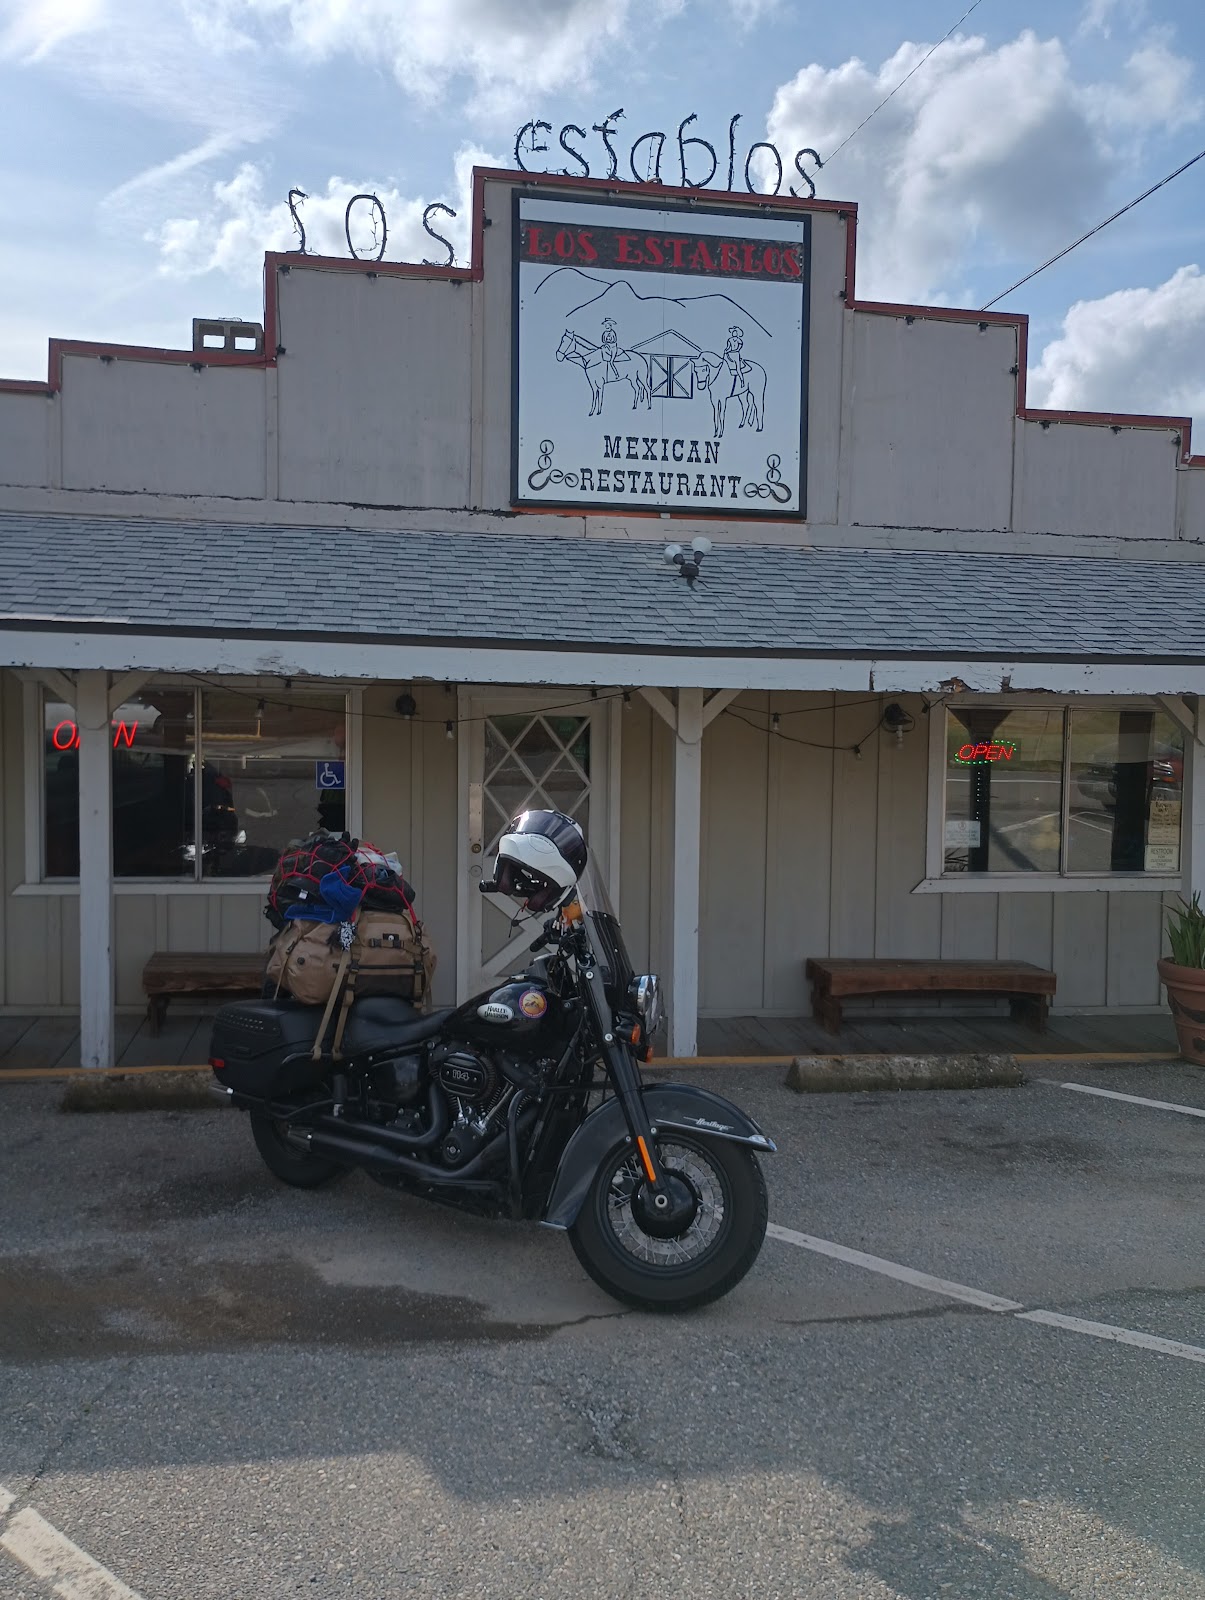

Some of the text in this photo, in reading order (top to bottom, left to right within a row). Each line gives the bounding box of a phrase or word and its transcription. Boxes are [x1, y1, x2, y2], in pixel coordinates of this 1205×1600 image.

[526, 227, 802, 277] LOS ESTABLOS
[603, 434, 721, 465] MEXICAN
[579, 467, 742, 499] RESTAURANT
[52, 719, 139, 751] ON
[959, 743, 1014, 761] OPEN
[693, 1117, 731, 1131] Heritage
